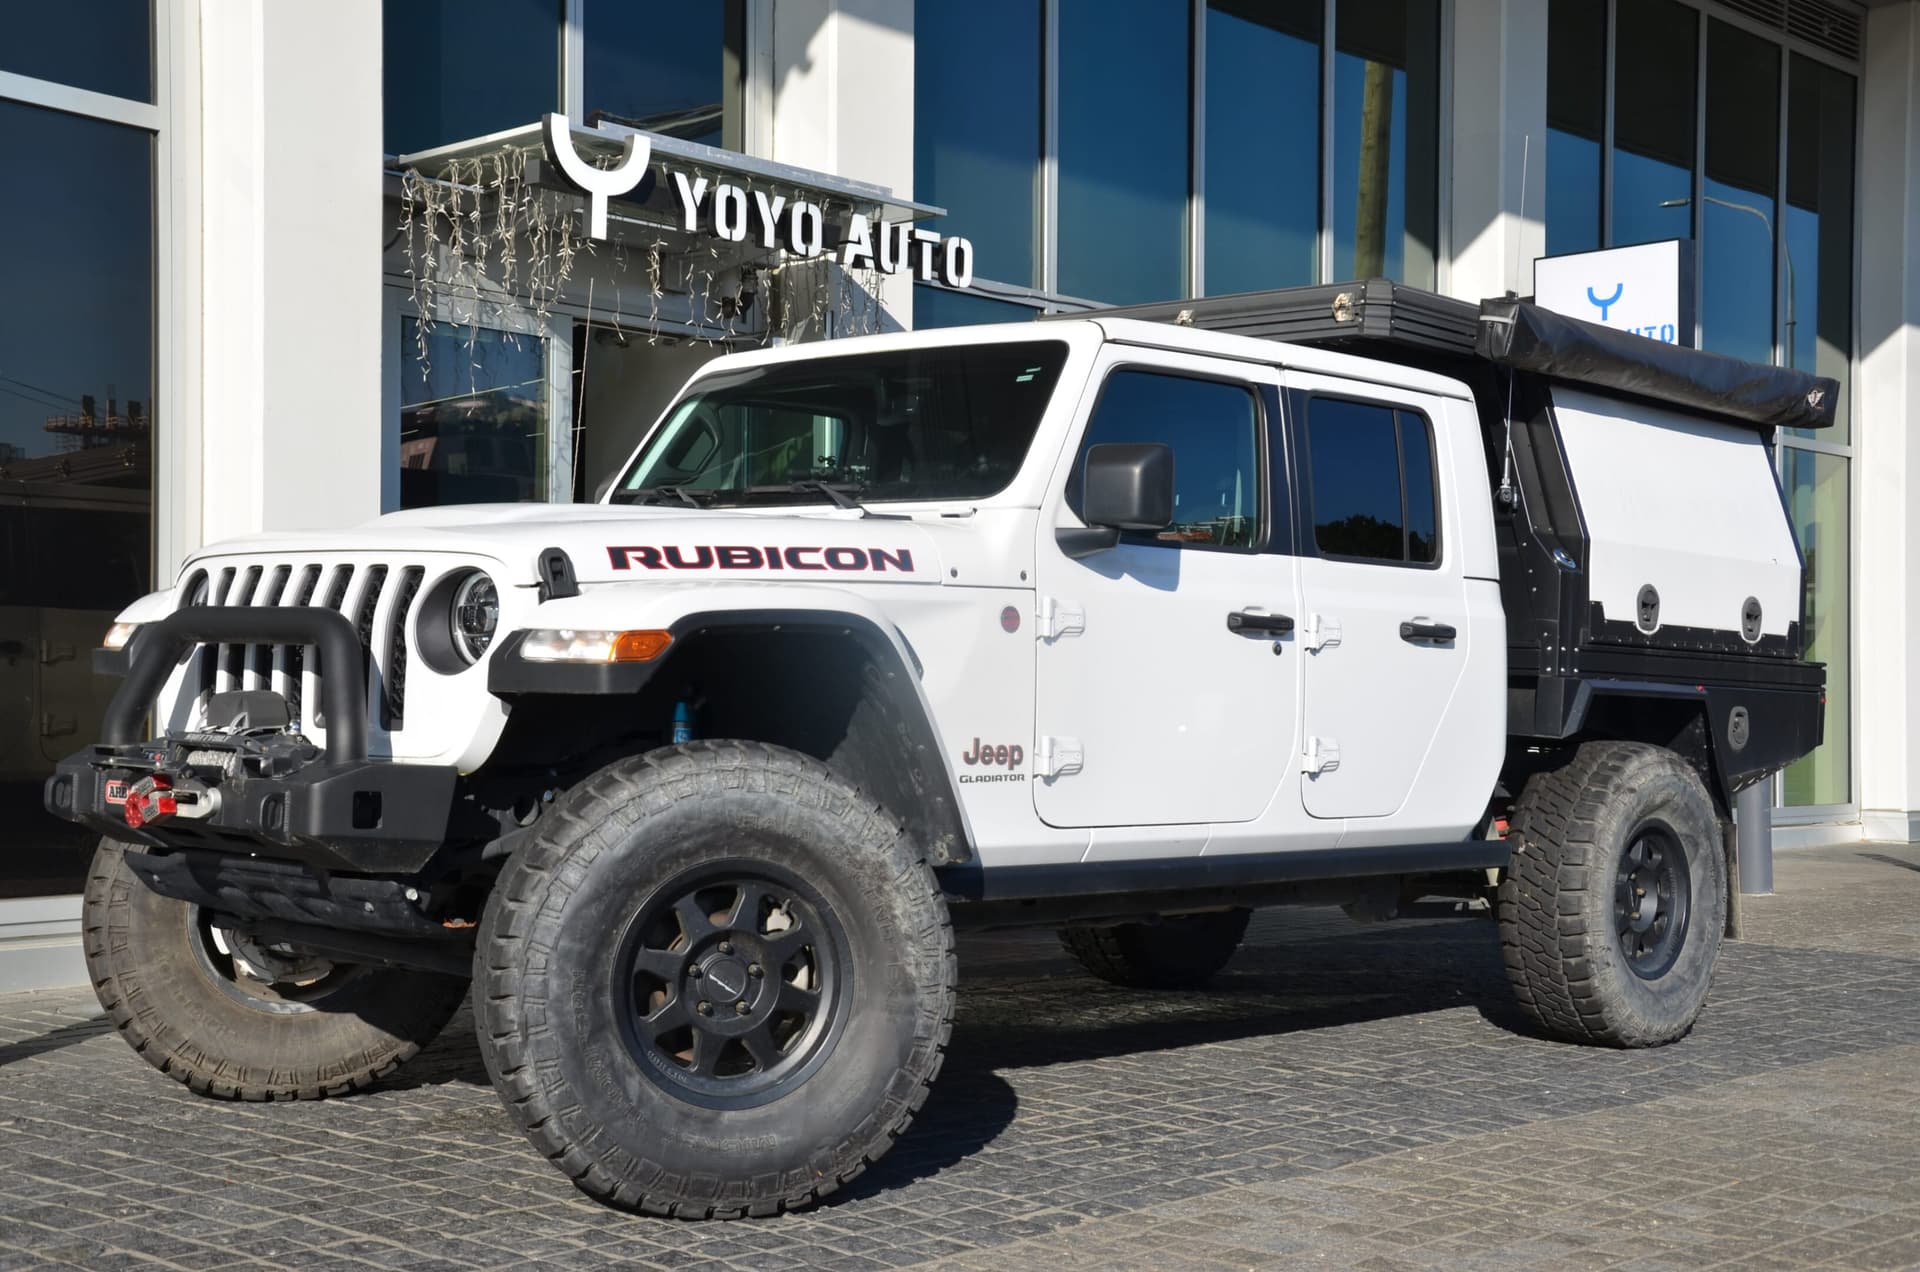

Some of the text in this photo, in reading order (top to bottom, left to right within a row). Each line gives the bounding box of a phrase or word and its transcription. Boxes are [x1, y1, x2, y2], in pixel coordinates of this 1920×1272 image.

[667, 171, 974, 288] YOYO AUTO
[606, 546, 915, 572] RUBICON
[963, 737, 1024, 770] Jeep
[959, 774, 1025, 784] GLADIATOR
